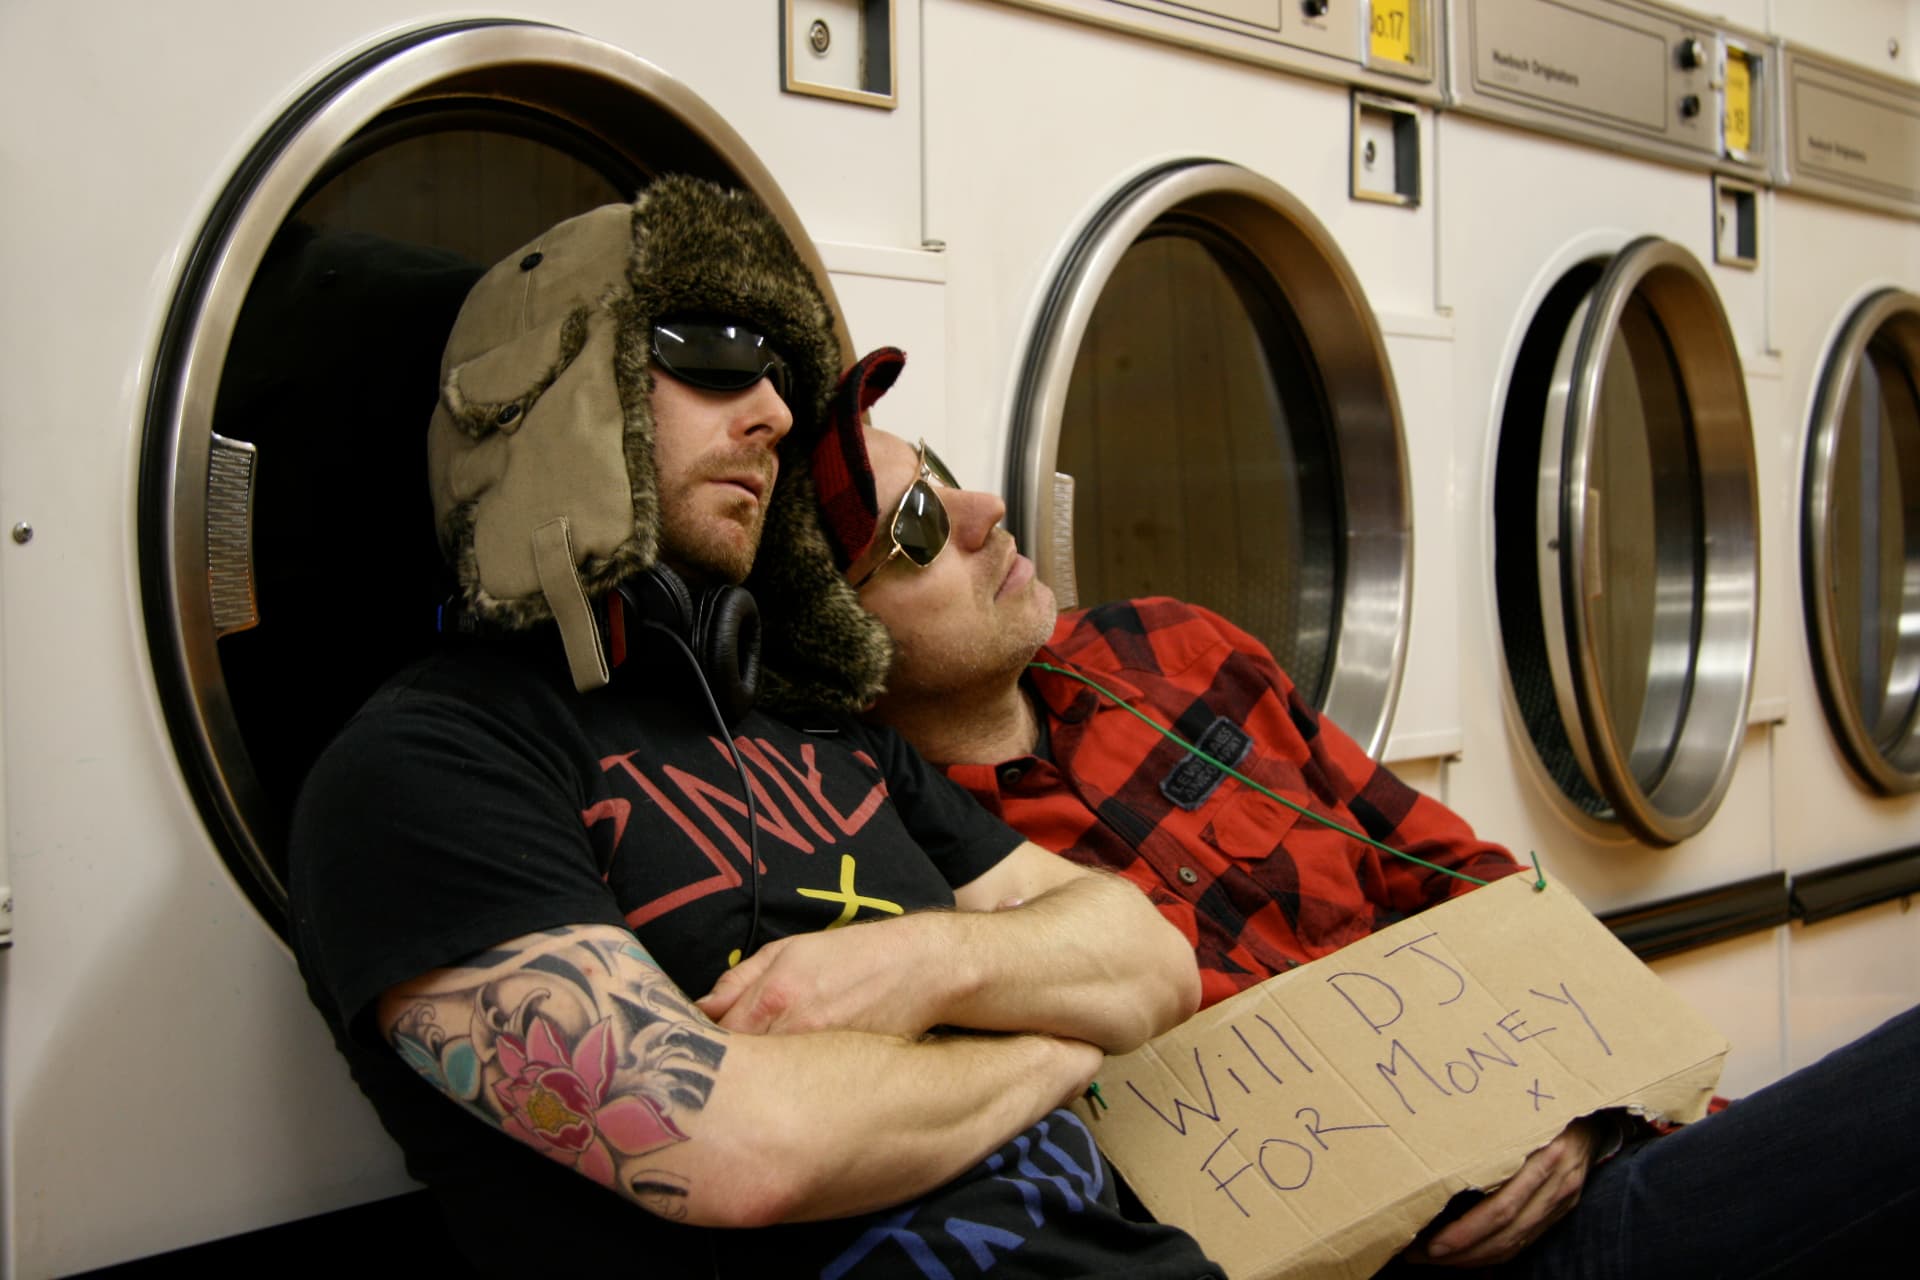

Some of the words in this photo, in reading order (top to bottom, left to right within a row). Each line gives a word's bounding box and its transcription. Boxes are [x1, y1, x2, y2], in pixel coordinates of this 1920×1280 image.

[1126, 1014, 1313, 1136] Will
[1326, 932, 1465, 1035] DJ
[1200, 1108, 1389, 1217] FOR
[1375, 982, 1612, 1114] MONEY
